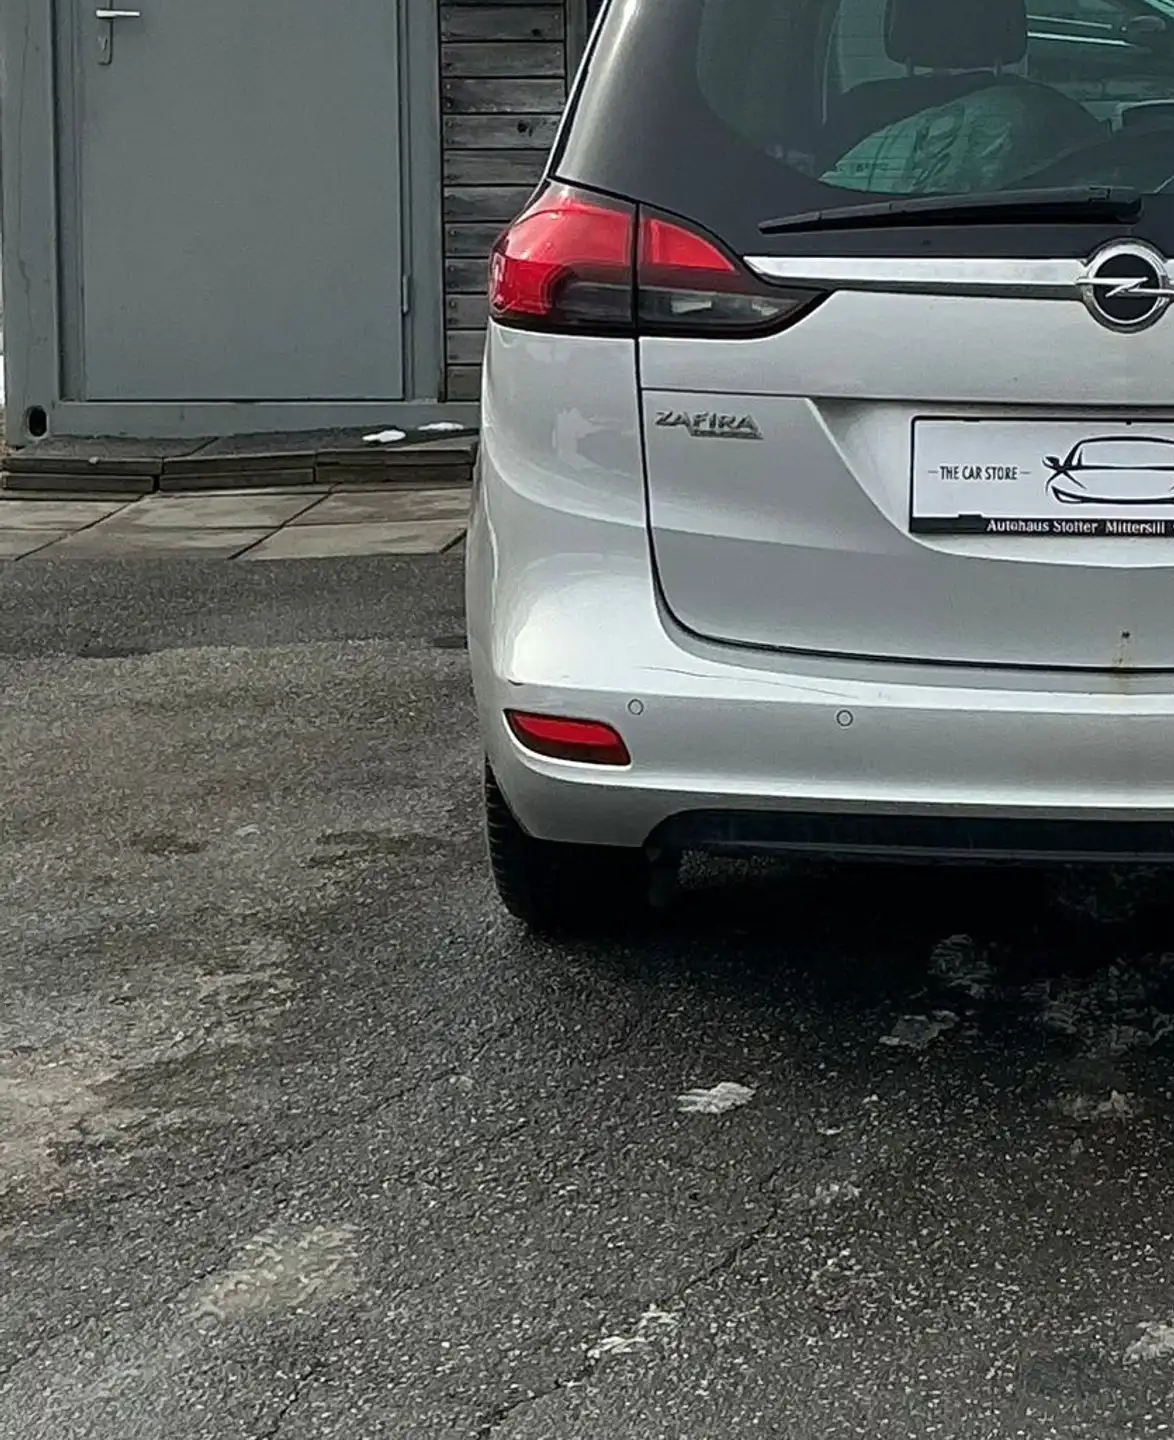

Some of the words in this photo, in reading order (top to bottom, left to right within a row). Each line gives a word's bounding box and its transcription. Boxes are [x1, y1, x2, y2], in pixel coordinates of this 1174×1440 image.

[655, 411, 763, 439] ZAFIRA
[940, 466, 959, 480] THE
[962, 466, 982, 480] CAR
[985, 467, 1018, 481] STORE
[986, 519, 1049, 532] Autohaus
[1105, 521, 1165, 534] Mittersill
